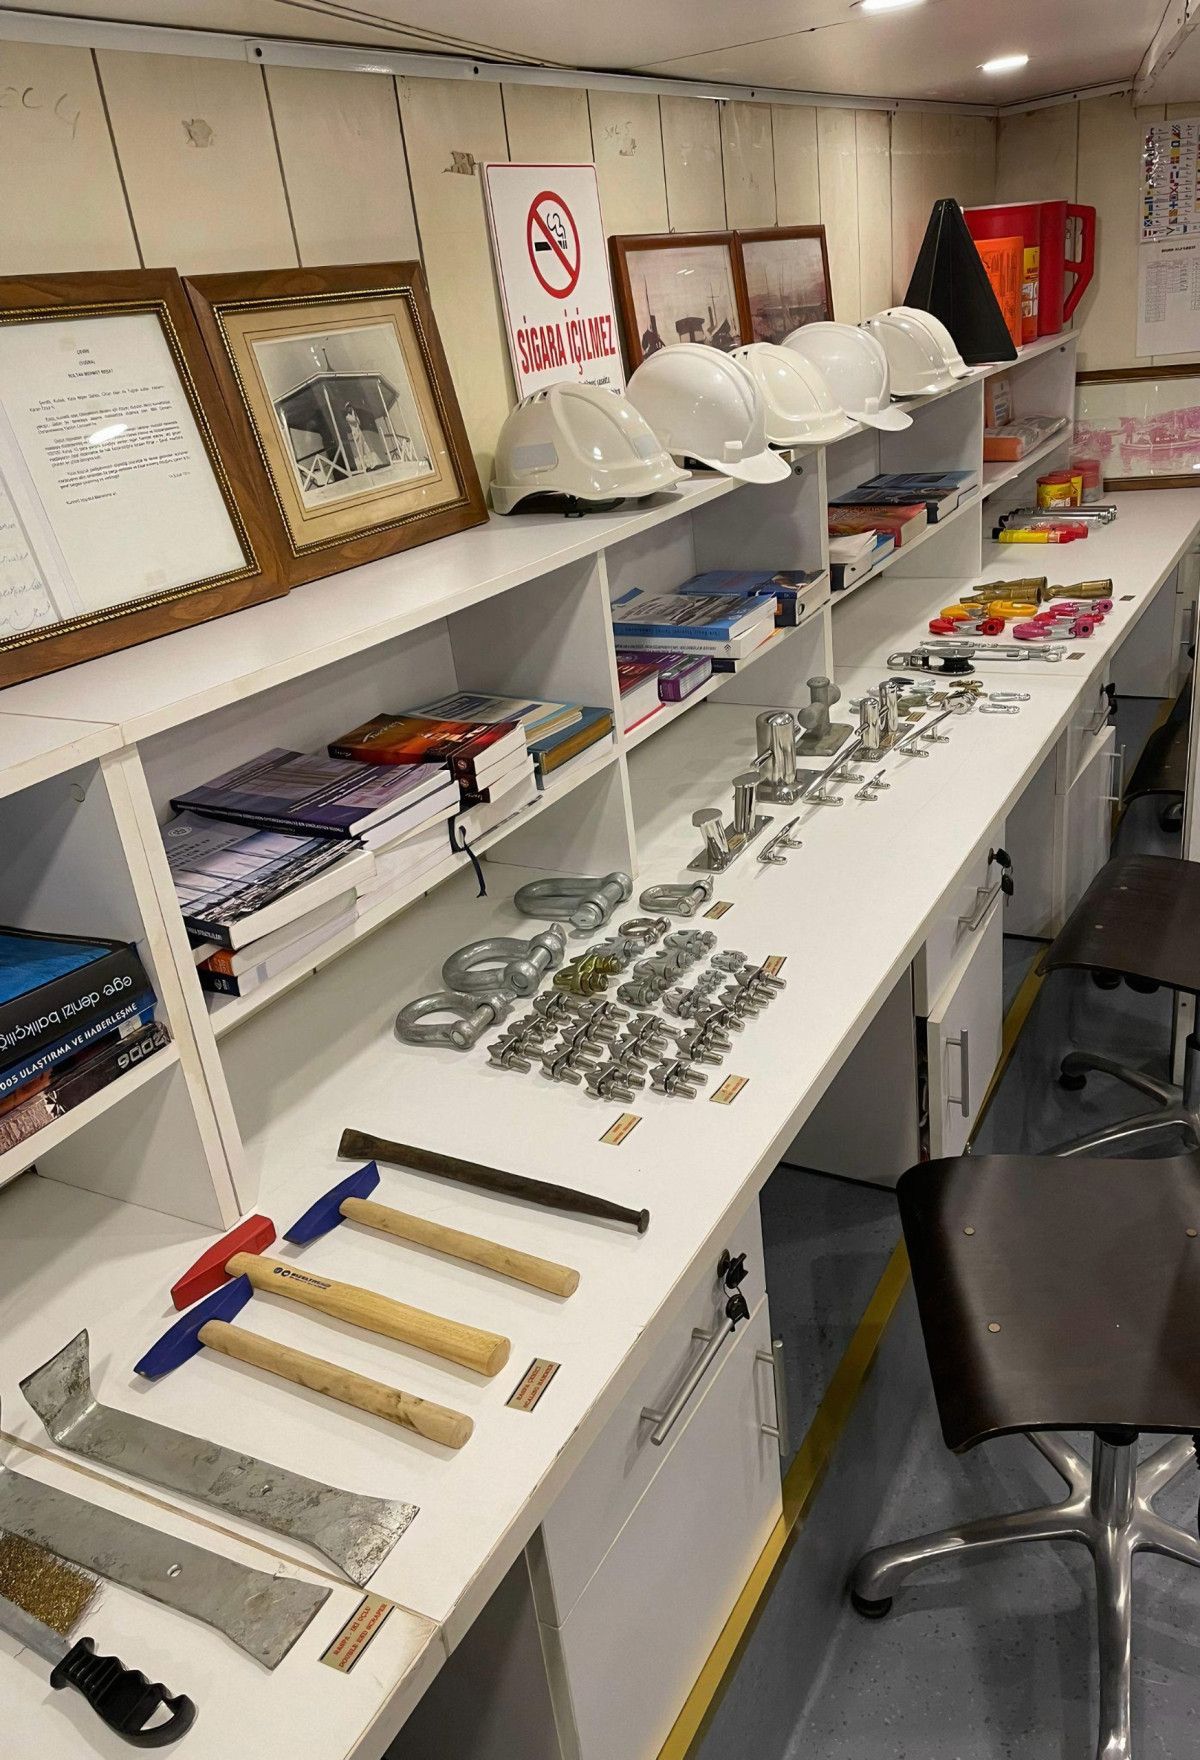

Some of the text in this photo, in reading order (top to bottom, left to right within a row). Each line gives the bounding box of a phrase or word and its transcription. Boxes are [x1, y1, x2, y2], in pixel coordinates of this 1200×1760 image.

[517, 307, 616, 375] SİGARA İÇİLMEZ
[102, 976, 132, 996] ege
[61, 992, 100, 1020] denizi
[19, 1044, 72, 1079] ULAŞTIRMA
[71, 1034, 84, 1046] VE
[84, 1002, 138, 1040] HABERLEŞME
[338, 1643, 359, 1668] DOUBLE
